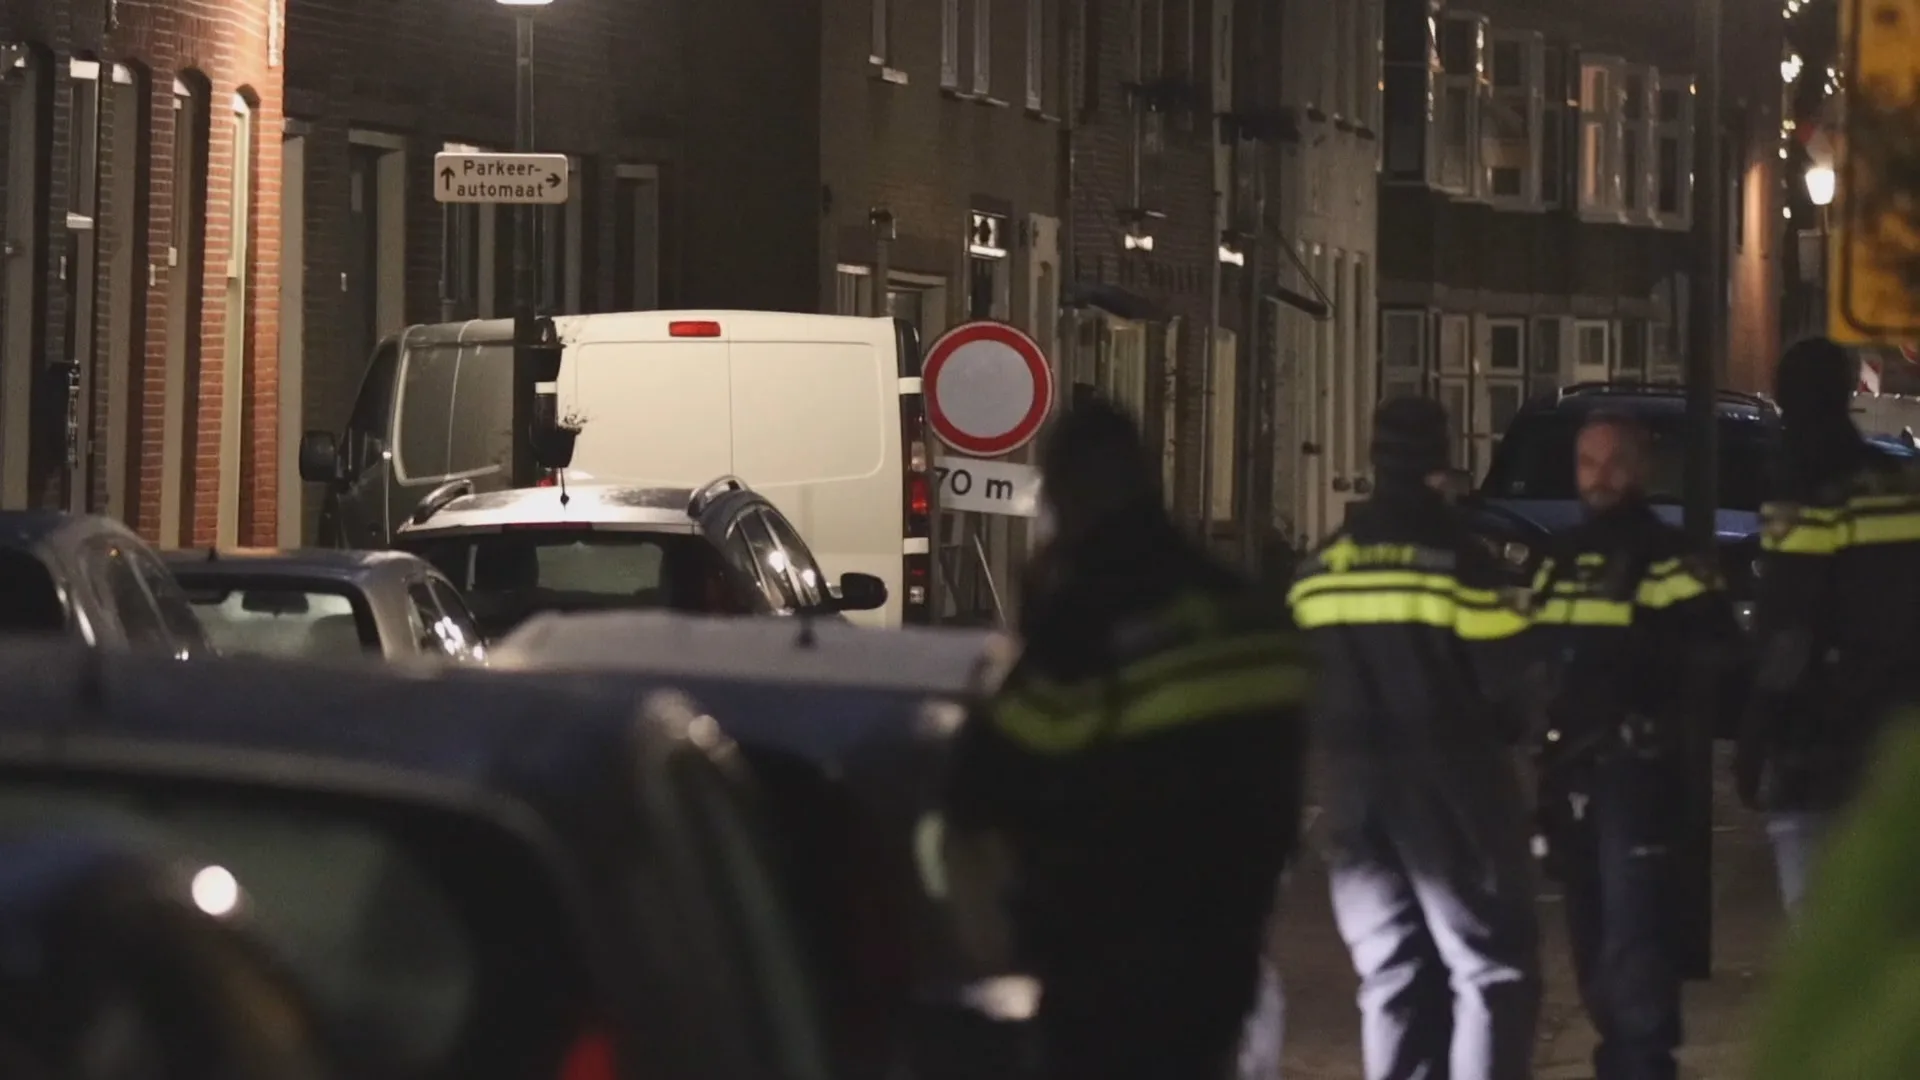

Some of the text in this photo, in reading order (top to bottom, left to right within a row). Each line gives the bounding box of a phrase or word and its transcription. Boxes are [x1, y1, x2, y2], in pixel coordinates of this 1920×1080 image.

[463, 160, 542, 176] Parkeer-
[457, 182, 544, 197] automaat
[985, 478, 1013, 500] m
